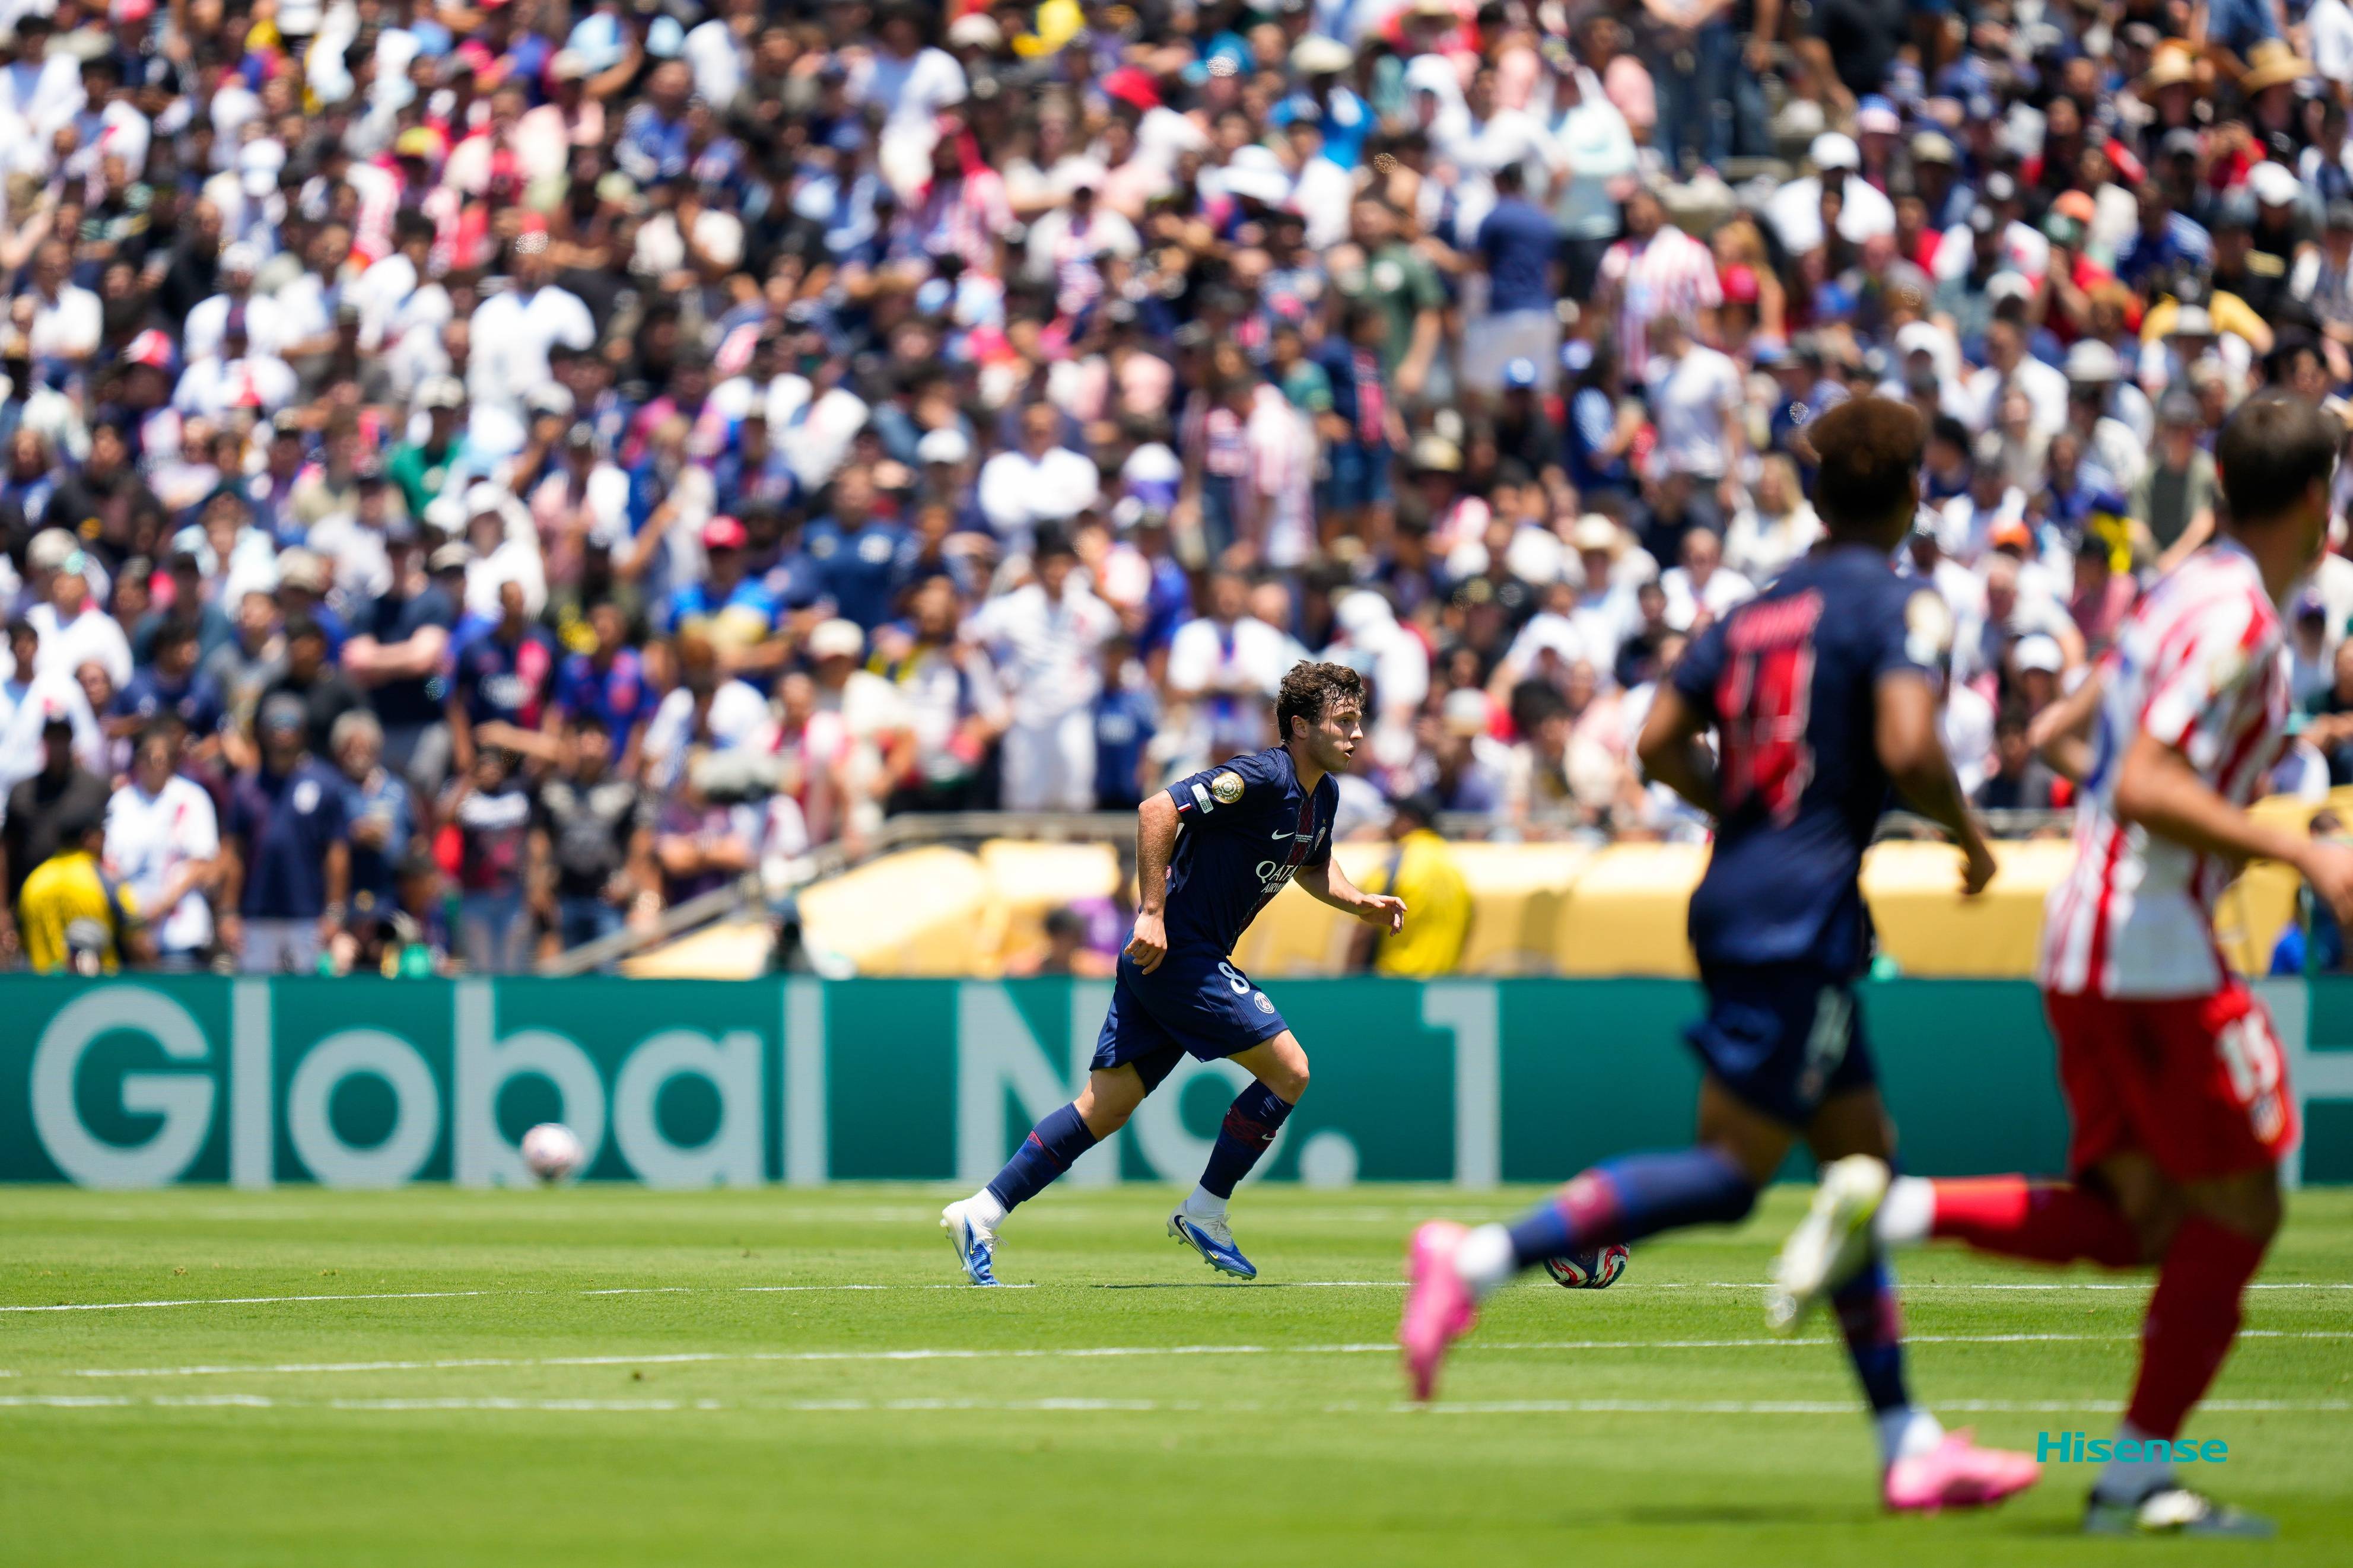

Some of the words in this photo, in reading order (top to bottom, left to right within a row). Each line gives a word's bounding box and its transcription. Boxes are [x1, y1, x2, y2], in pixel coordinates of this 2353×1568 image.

[1214, 785, 1223, 798] FIFA
[1255, 860, 1302, 884] QATA
[1218, 962, 1250, 994] 8
[30, 977, 826, 1189] Global
[957, 979, 1360, 1189] No.
[1424, 979, 1502, 1189] 1
